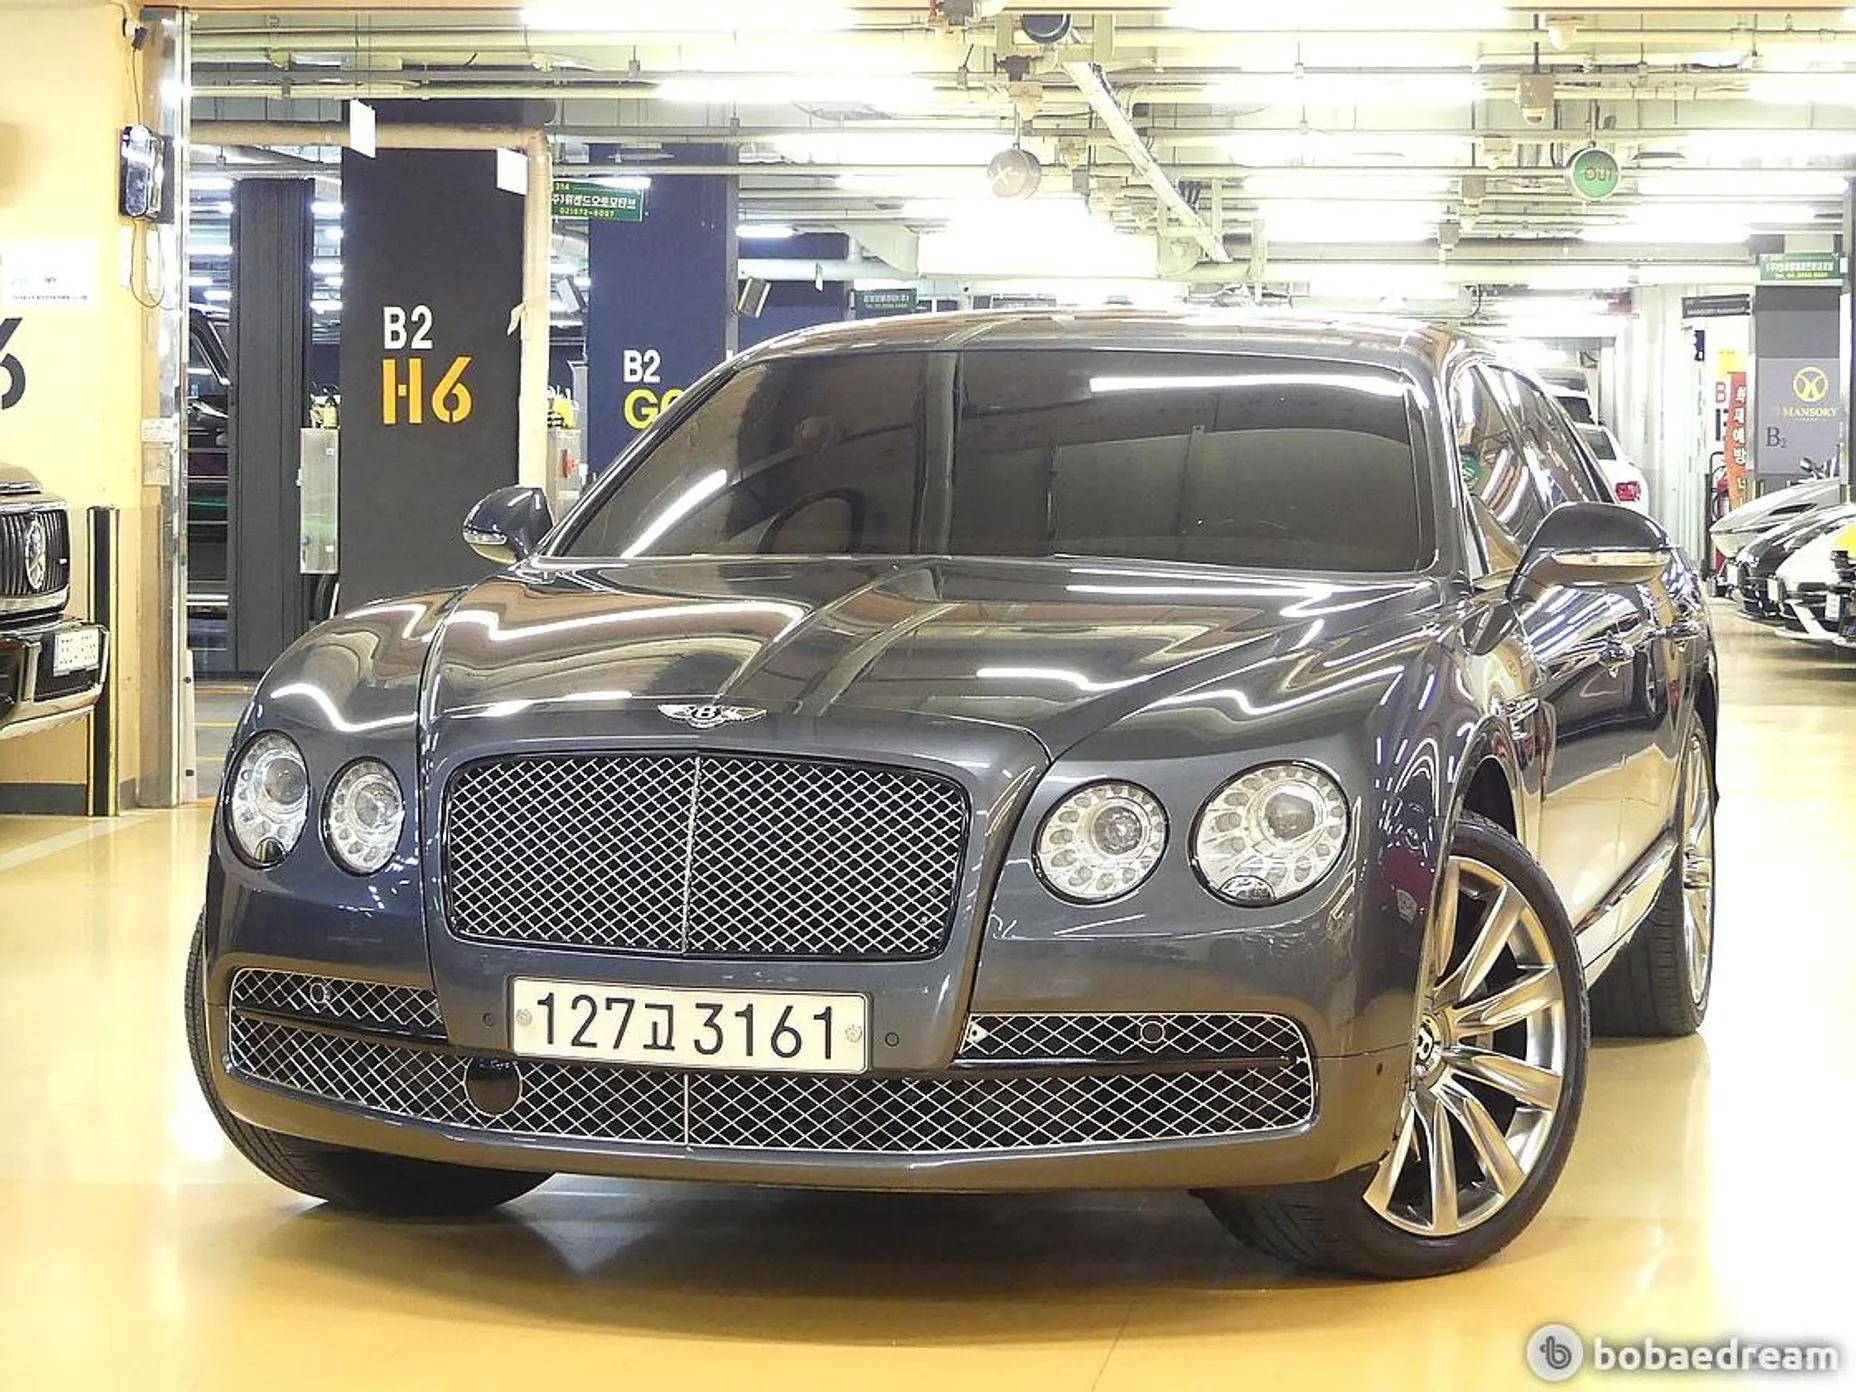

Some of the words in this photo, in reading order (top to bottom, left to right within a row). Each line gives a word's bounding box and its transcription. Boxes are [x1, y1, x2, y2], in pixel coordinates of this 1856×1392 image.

[1584, 166, 1613, 182] OUT
[383, 304, 434, 350] B2
[623, 349, 661, 384] B2
[382, 356, 473, 425] H6
[1783, 406, 1837, 418] MANSORY
